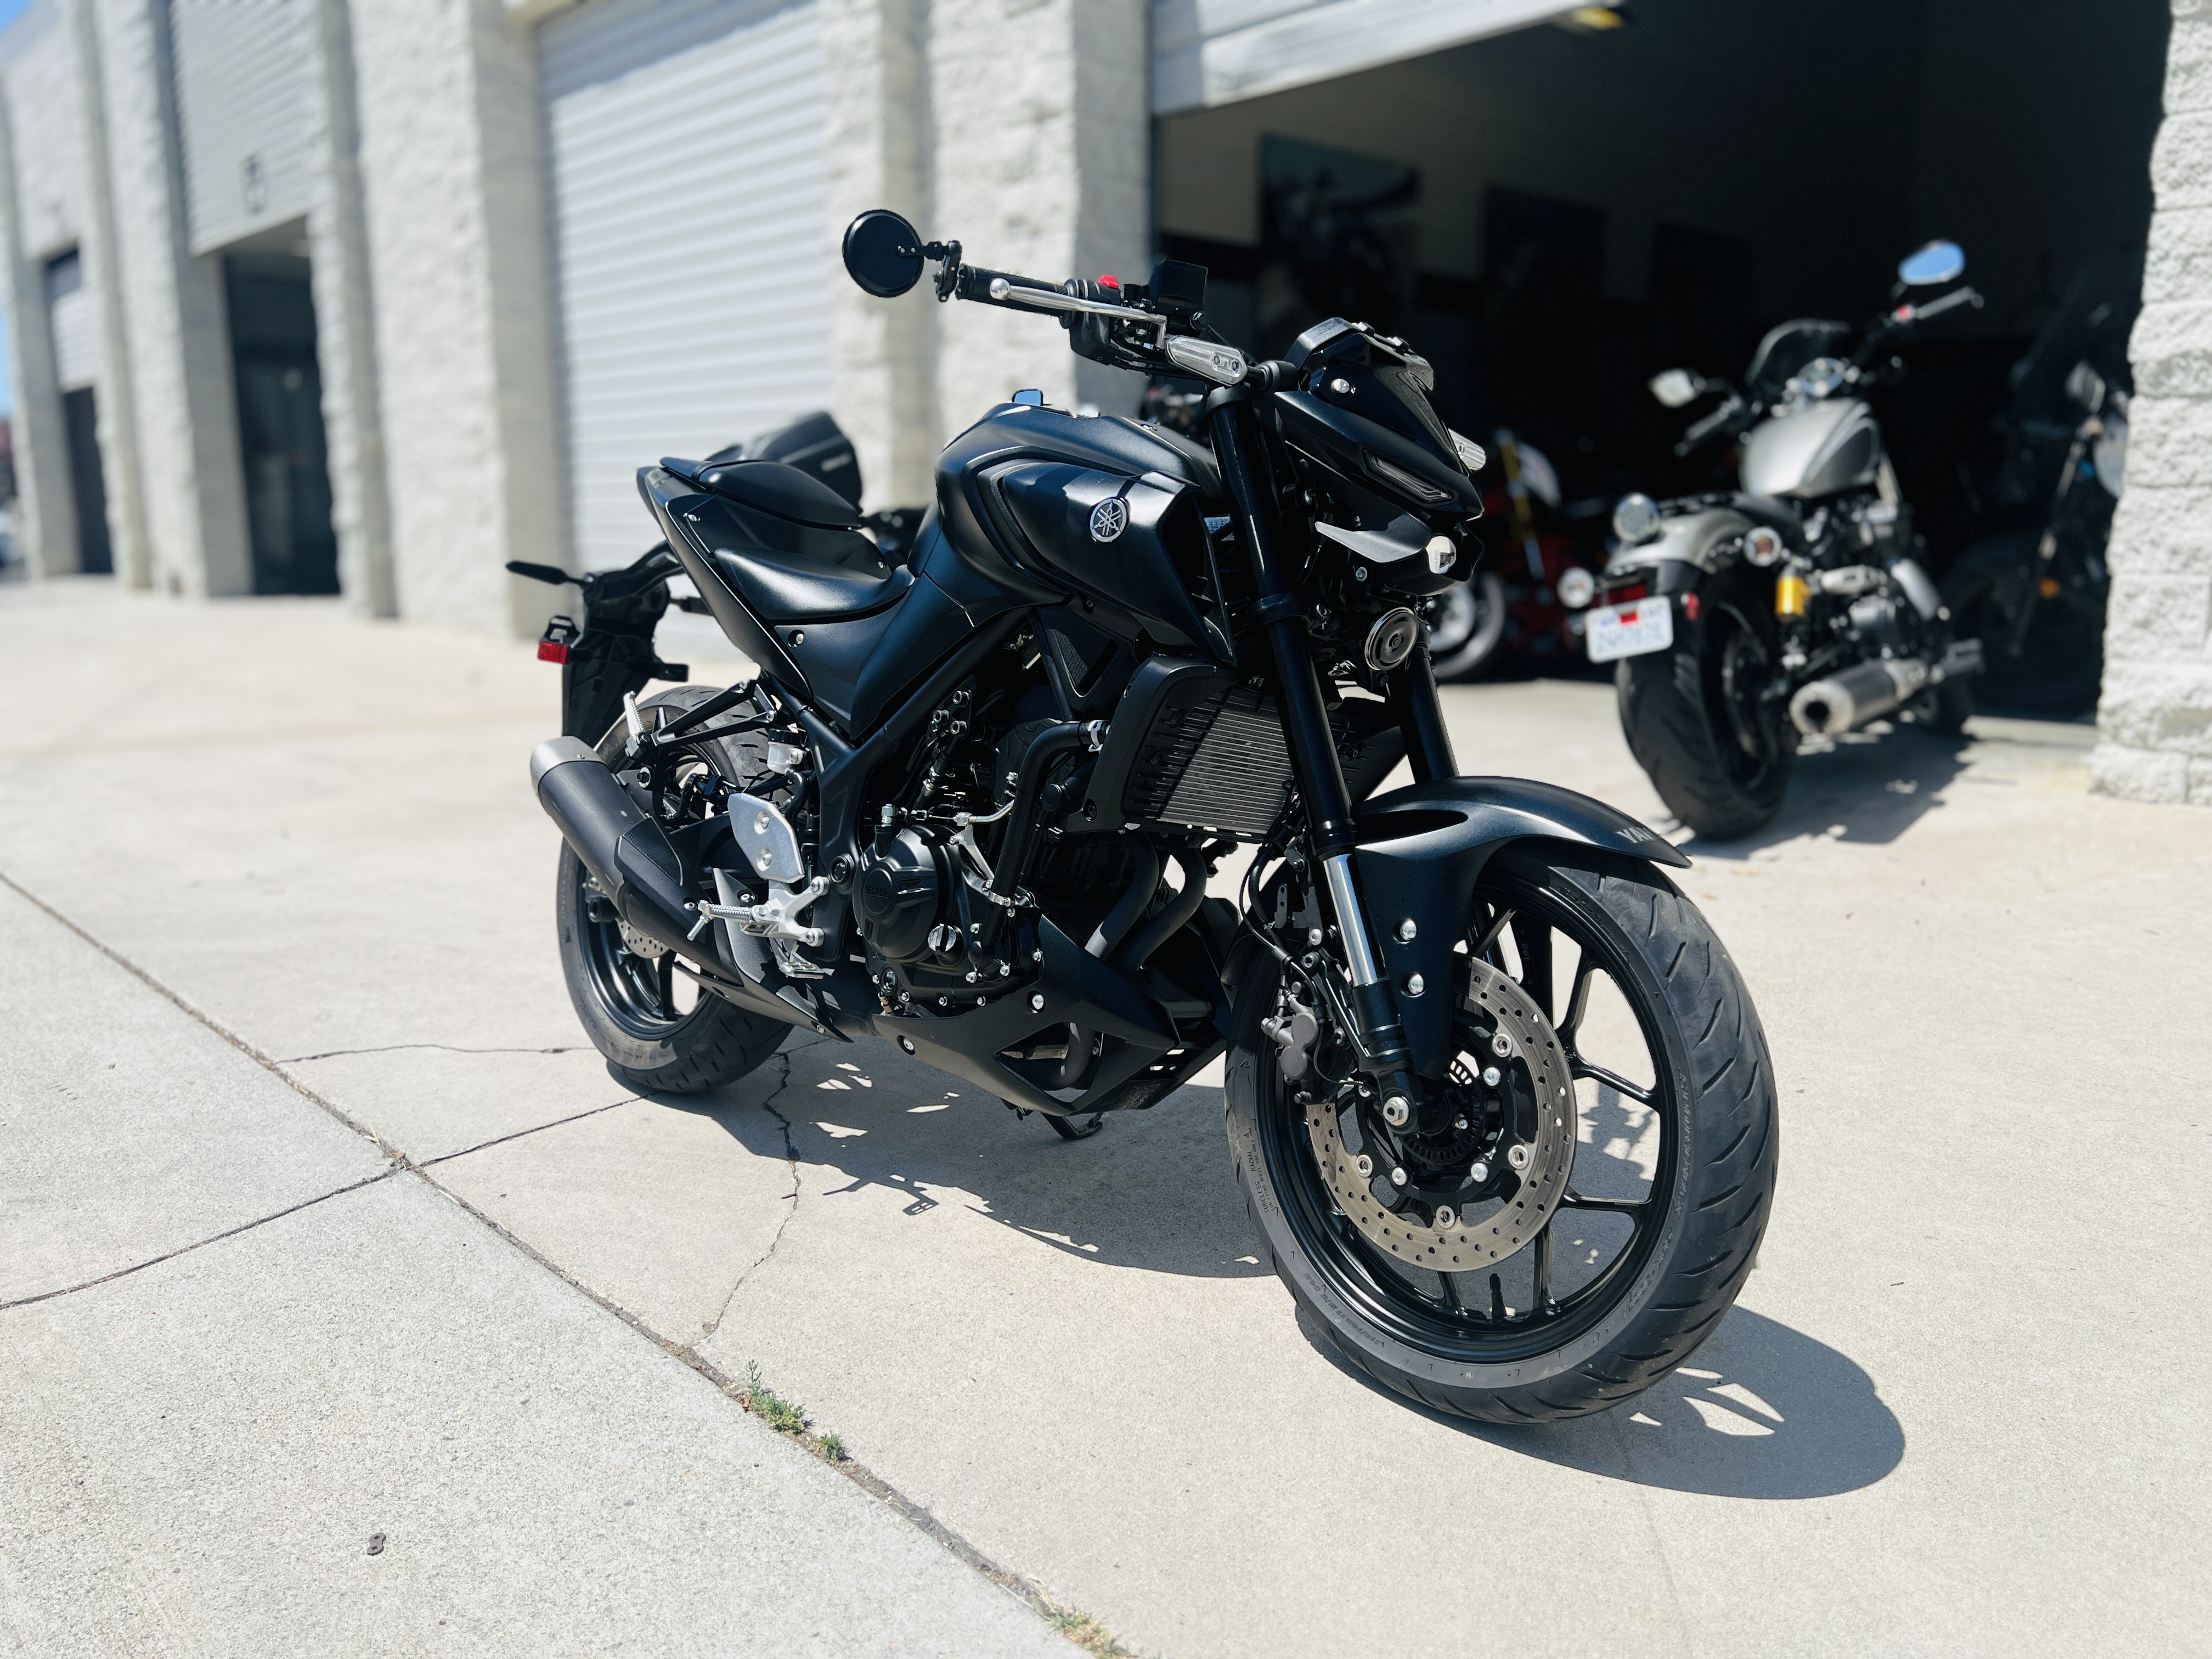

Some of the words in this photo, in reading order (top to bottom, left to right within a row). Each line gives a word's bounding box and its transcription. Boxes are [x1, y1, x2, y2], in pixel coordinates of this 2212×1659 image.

[865, 885, 889, 898] YAMAHA
[1248, 1150, 1256, 1172] RADIAL
[1255, 1181, 1270, 1214] TUBELESS
